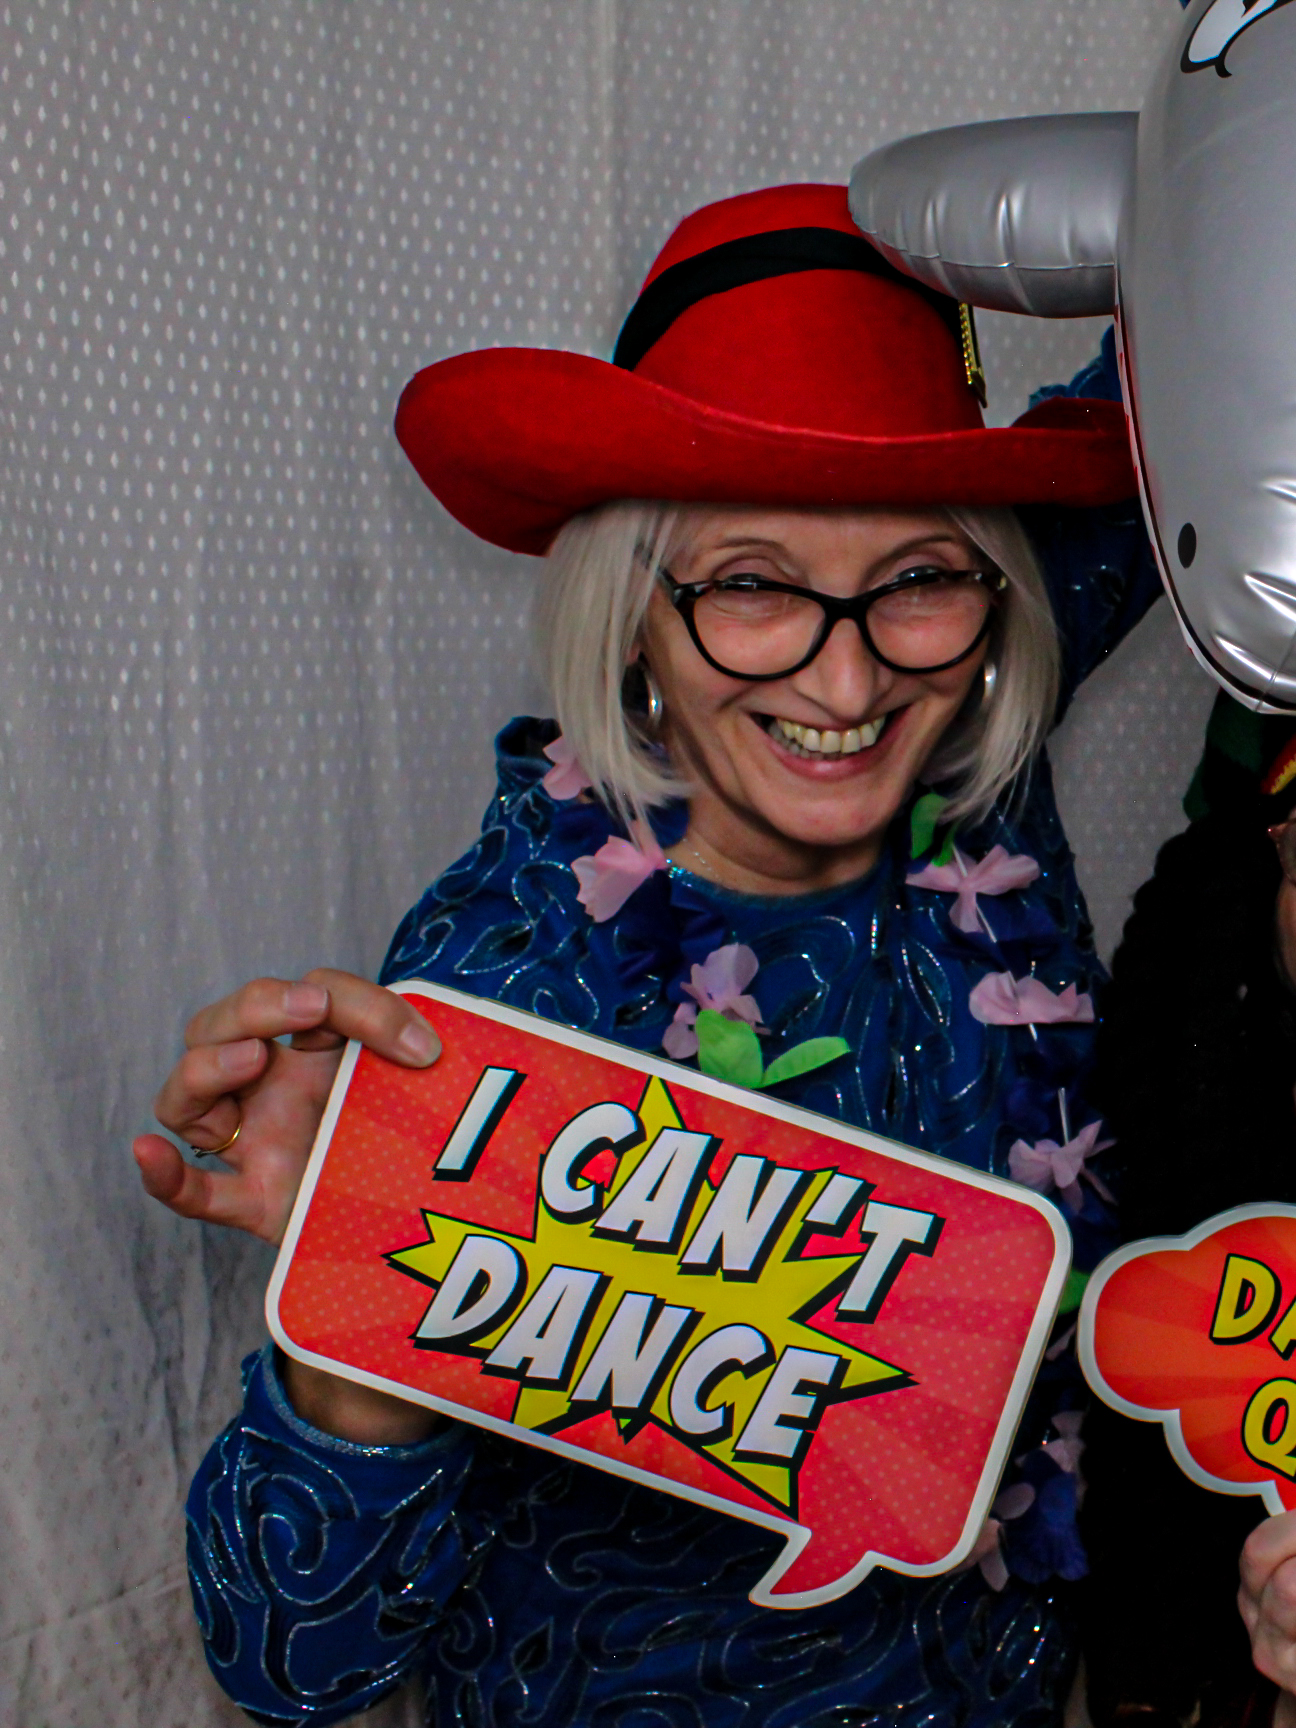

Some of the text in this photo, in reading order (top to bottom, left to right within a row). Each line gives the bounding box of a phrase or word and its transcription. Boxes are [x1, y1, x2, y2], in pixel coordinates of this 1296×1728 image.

[432, 1065, 946, 1323] I CAN'T
[412, 1233, 842, 1468] DANCE
